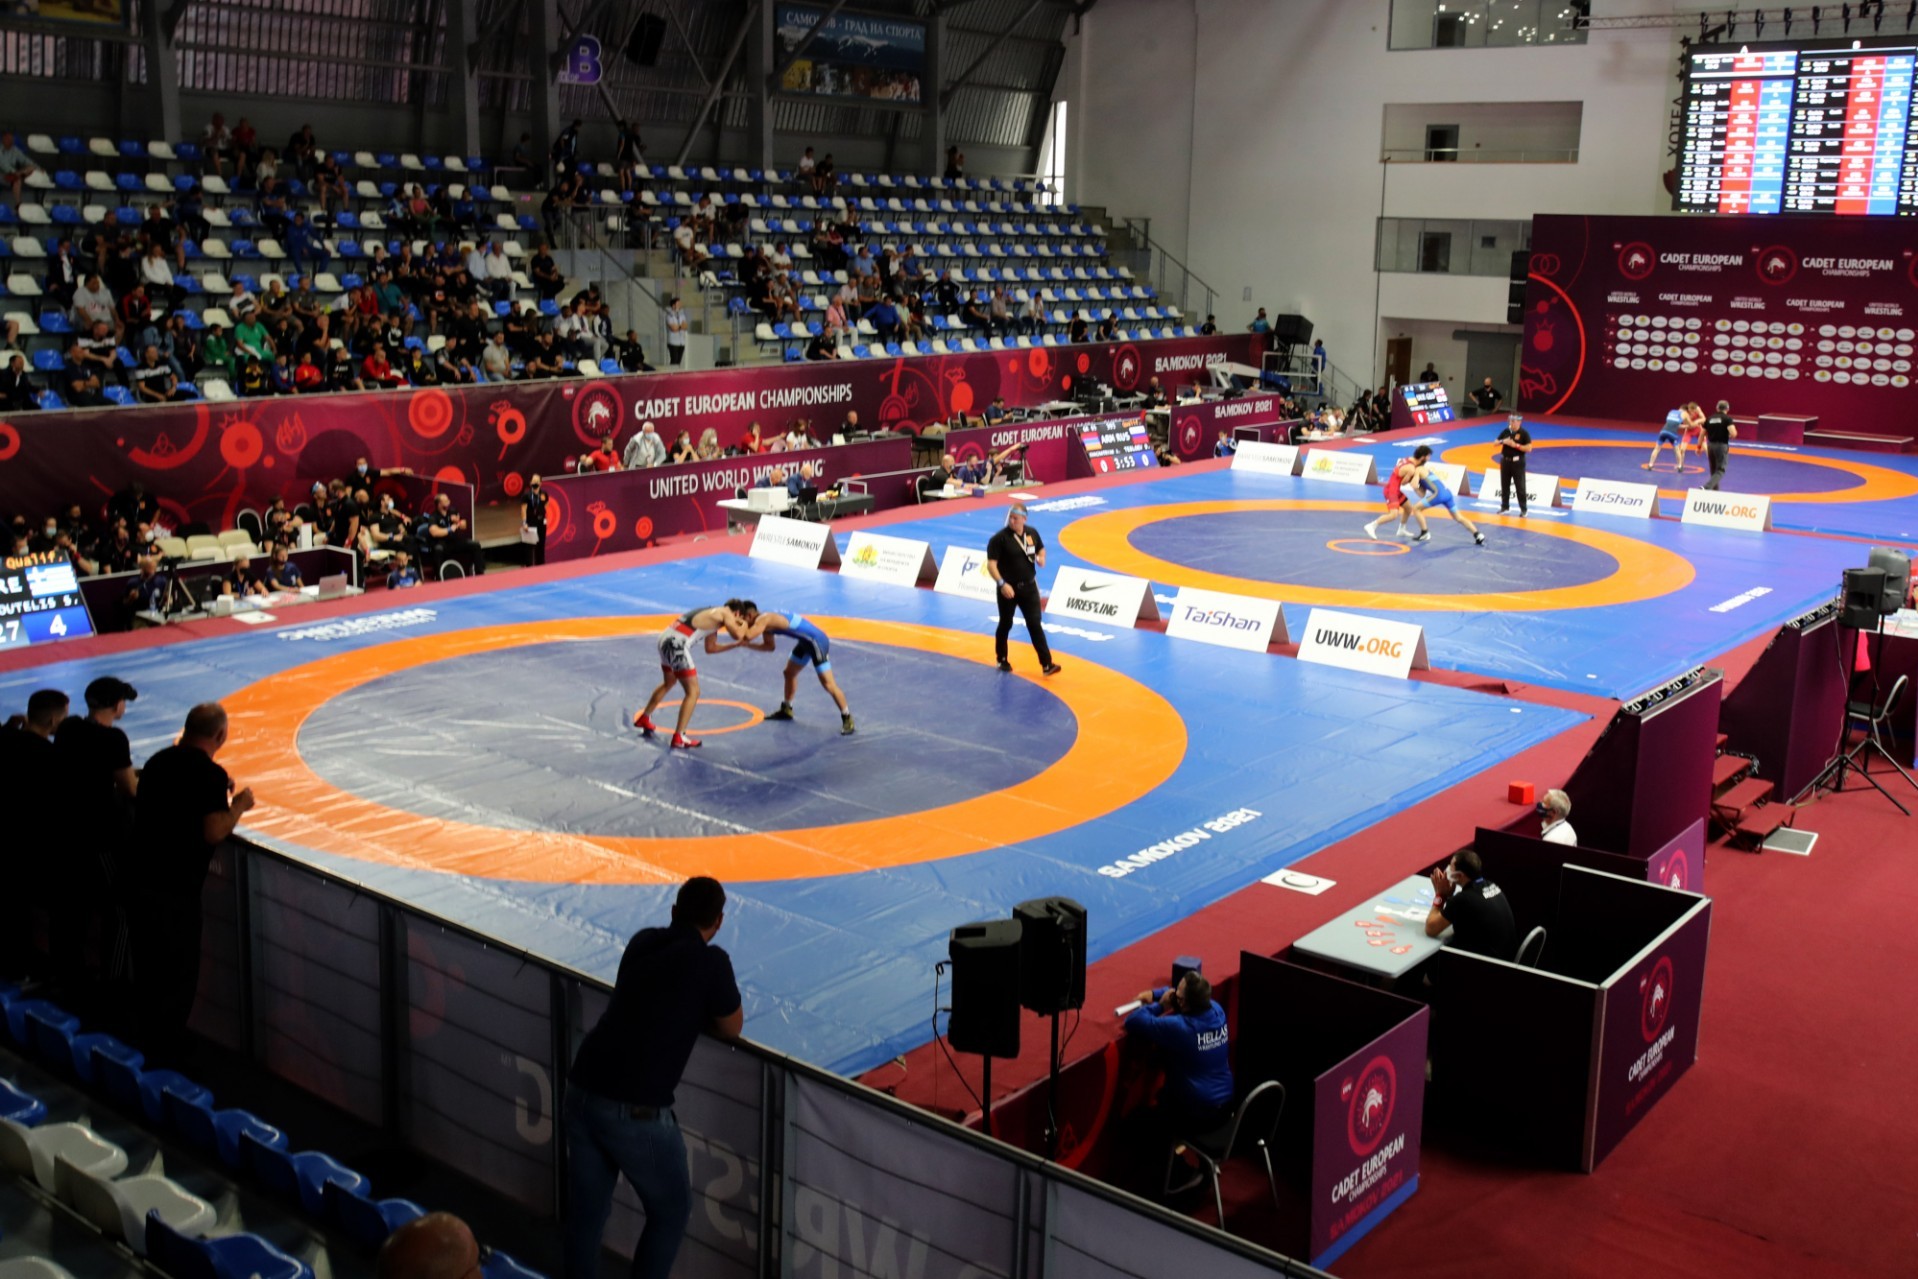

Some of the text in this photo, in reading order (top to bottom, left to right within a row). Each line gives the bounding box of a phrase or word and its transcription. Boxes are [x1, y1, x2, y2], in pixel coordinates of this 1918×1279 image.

[870, 23, 884, 34] НА
[1660, 253, 1743, 266] CADET EUROPEAN
[1802, 257, 1894, 271] CADET EUROPEAN
[1607, 295, 1640, 304] WRESTLING
[1730, 301, 1765, 310] WRESTLING
[1864, 307, 1903, 316] WRESTLING
[1155, 352, 1227, 373] SAMOKOV 2021
[634, 383, 853, 420] CADET EUROPEAN CHAMPIONSHIPS
[1215, 400, 1273, 419] SAMOKOV 2021
[991, 430, 1018, 447] CADET
[1020, 426, 1063, 444] EUROPEAN
[1113, 456, 1136, 470] 3:53
[649, 458, 824, 500] UNITED WORLD WRSTLNG
[1585, 490, 1644, 508] TaiShan
[1693, 500, 1757, 519] UWW.ORG
[1066, 597, 1119, 617] WRESTLING
[49, 613, 68, 637] 4
[1184, 605, 1262, 633] TaiShan
[1315, 628, 1403, 659] UWW.ORG
[1097, 807, 1263, 879] SAMOKOV 2021
[1197, 1023, 1228, 1045] HELLAS
[1627, 1053, 1646, 1082] CADET
[1331, 1133, 1405, 1204] CADET EUROPEAN
[1348, 1164, 1387, 1203] CHAMPIONSHIPS
